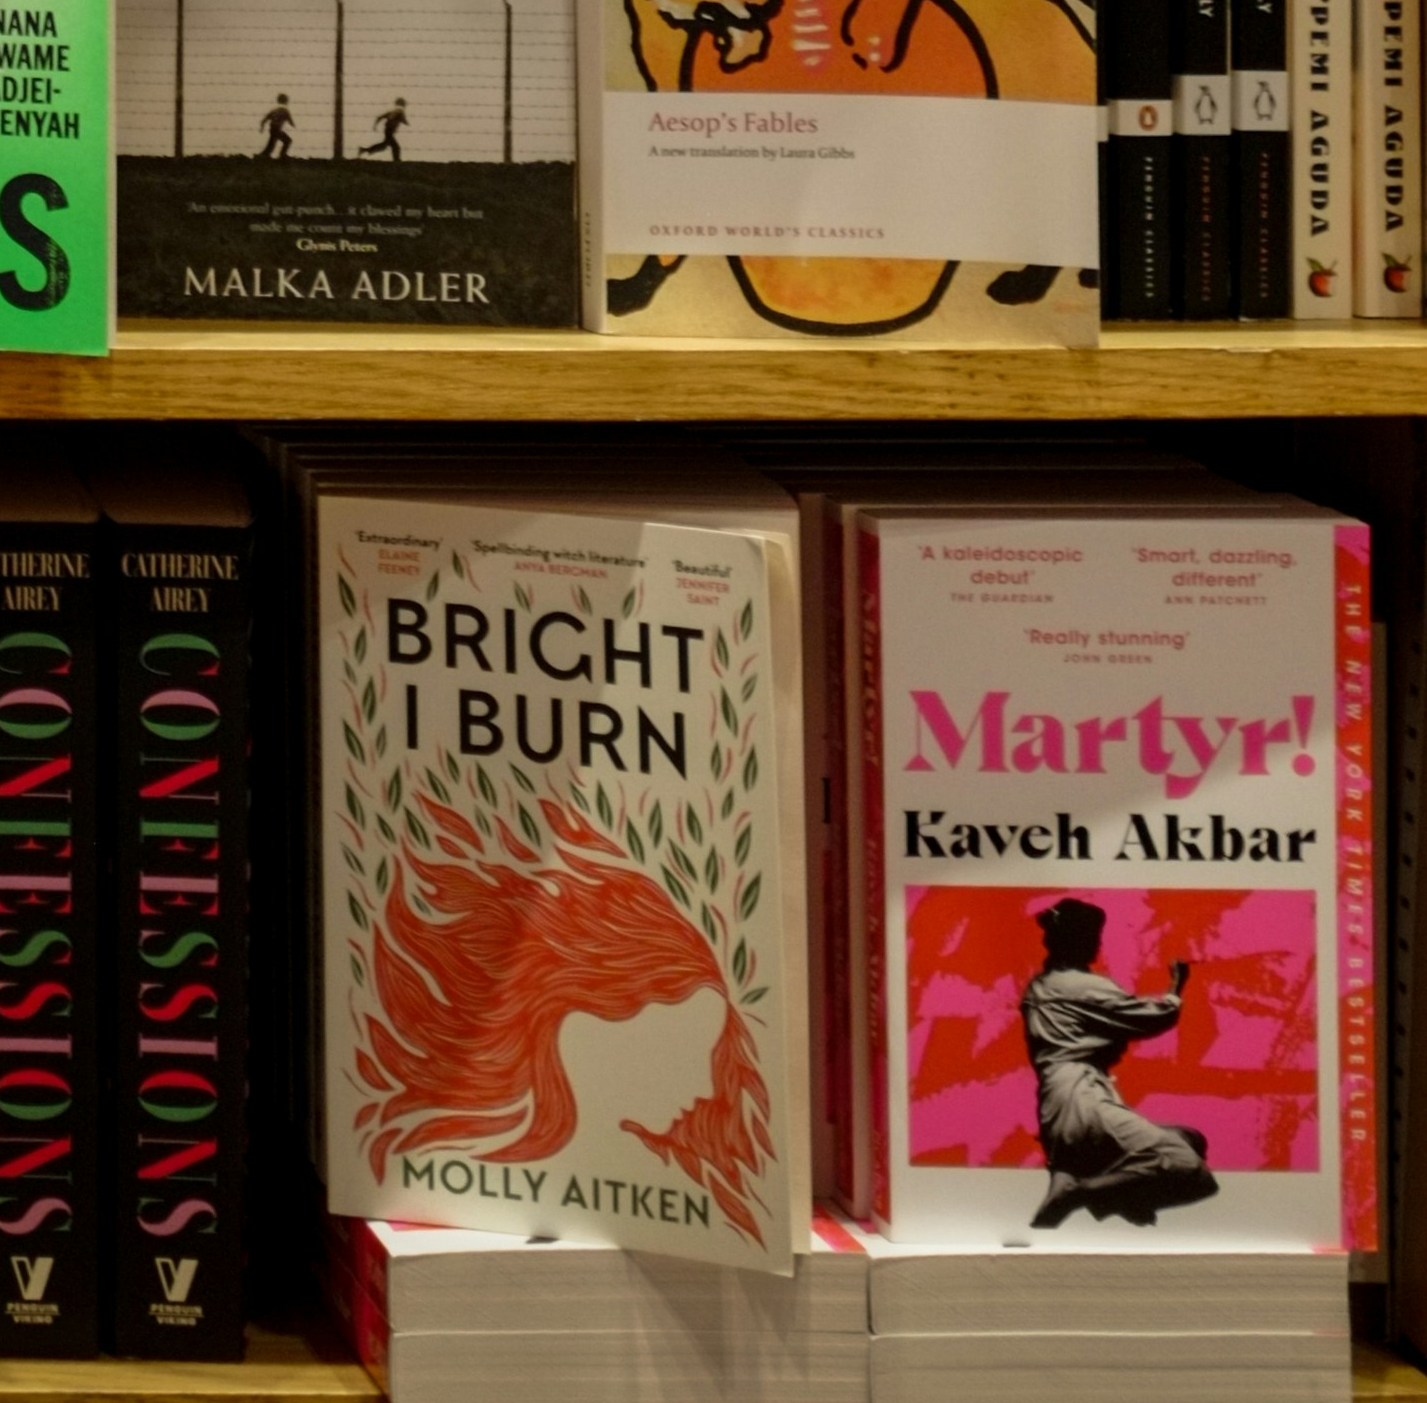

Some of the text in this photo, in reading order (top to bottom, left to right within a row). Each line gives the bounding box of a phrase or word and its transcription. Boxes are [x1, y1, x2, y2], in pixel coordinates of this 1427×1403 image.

[648, 111, 819, 138] Aesop's Fables
[649, 226, 719, 239] OXFORD
[808, 226, 886, 240] CLASSICS
[184, 268, 491, 305] MALKA ADLER
[1, 586, 62, 615] AIREY
[388, 598, 705, 694] BRIGHT
[407, 684, 688, 780] I BURN
[903, 690, 1318, 800] Martyr!
[903, 810, 1318, 864] Kaveh Akbar
[403, 1156, 711, 1229] MOLLY AITKEN
